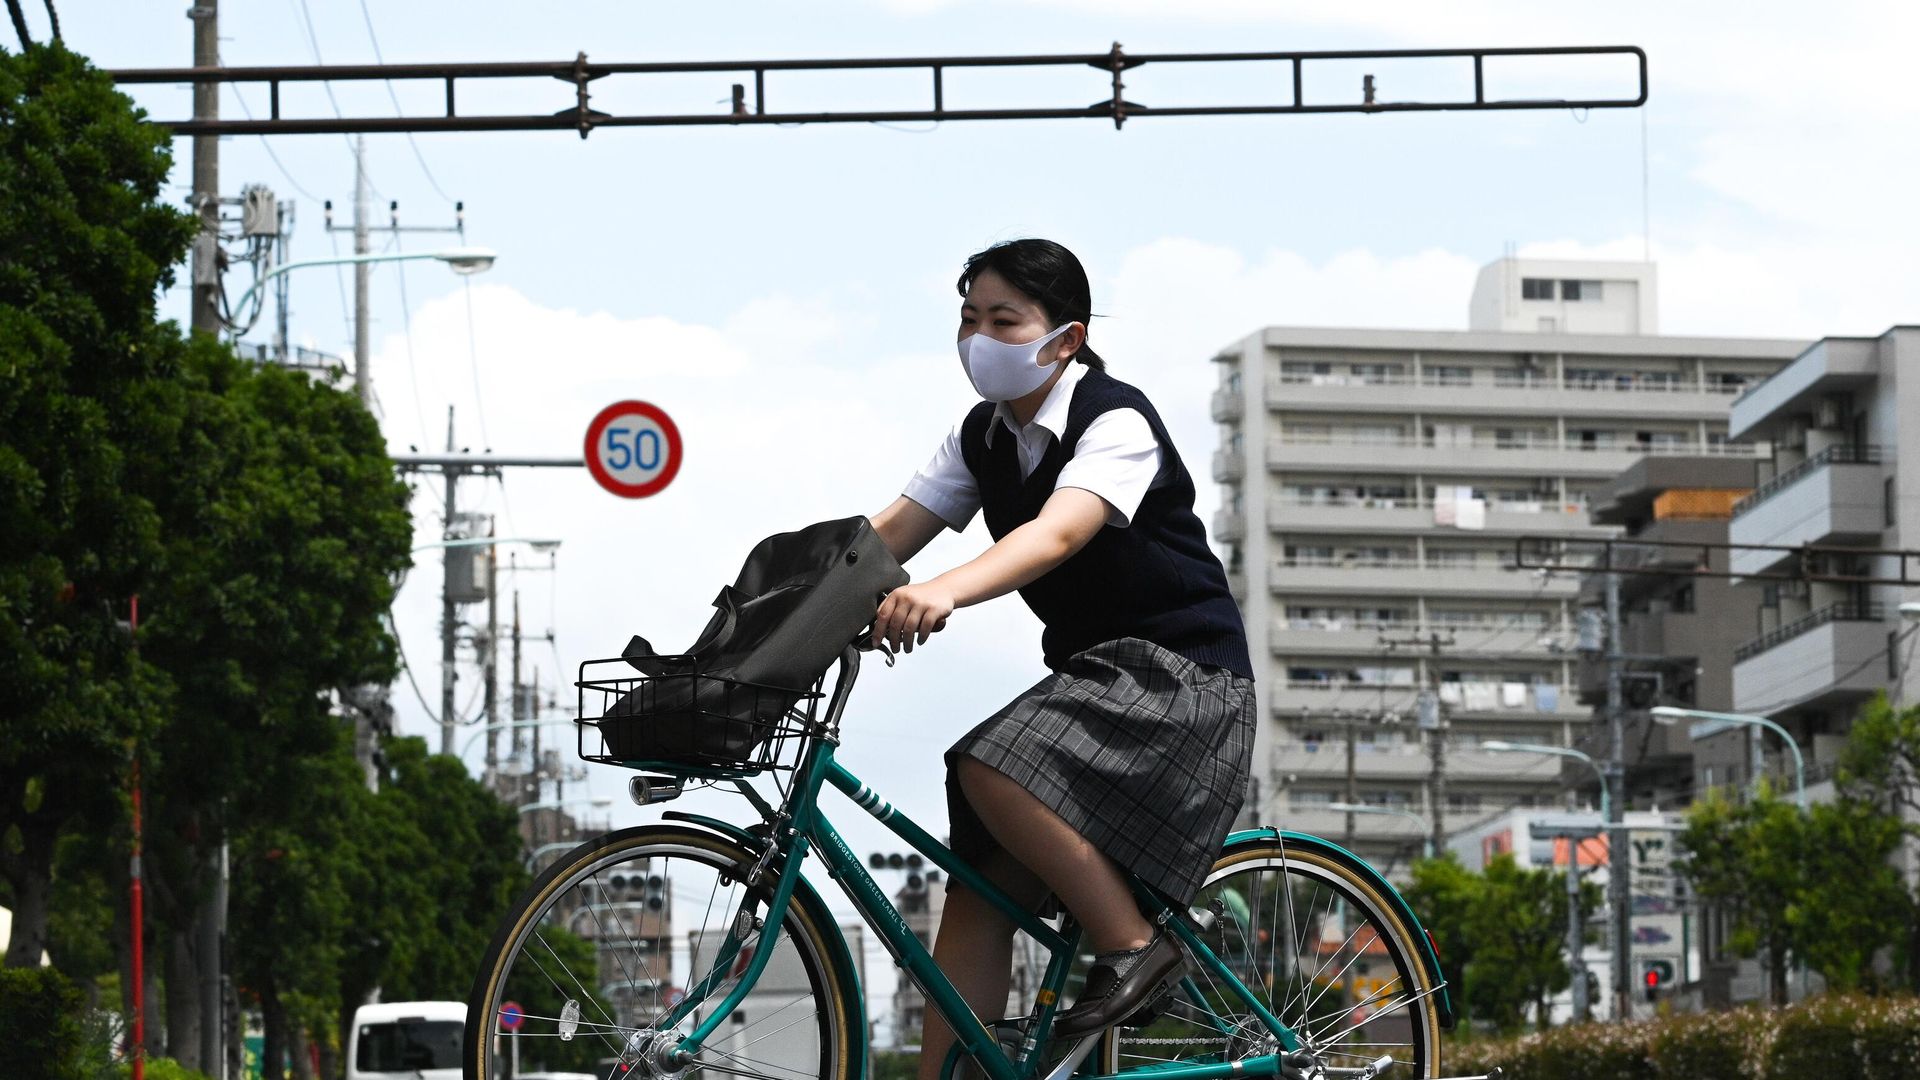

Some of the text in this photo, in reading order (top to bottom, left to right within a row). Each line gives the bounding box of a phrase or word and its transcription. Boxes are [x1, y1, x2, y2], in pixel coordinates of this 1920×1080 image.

[607, 428, 660, 471] 50
[829, 831, 866, 878] BRIDGESTONE
[864, 877, 884, 902] GREEN
[881, 900, 899, 923] LABEL
